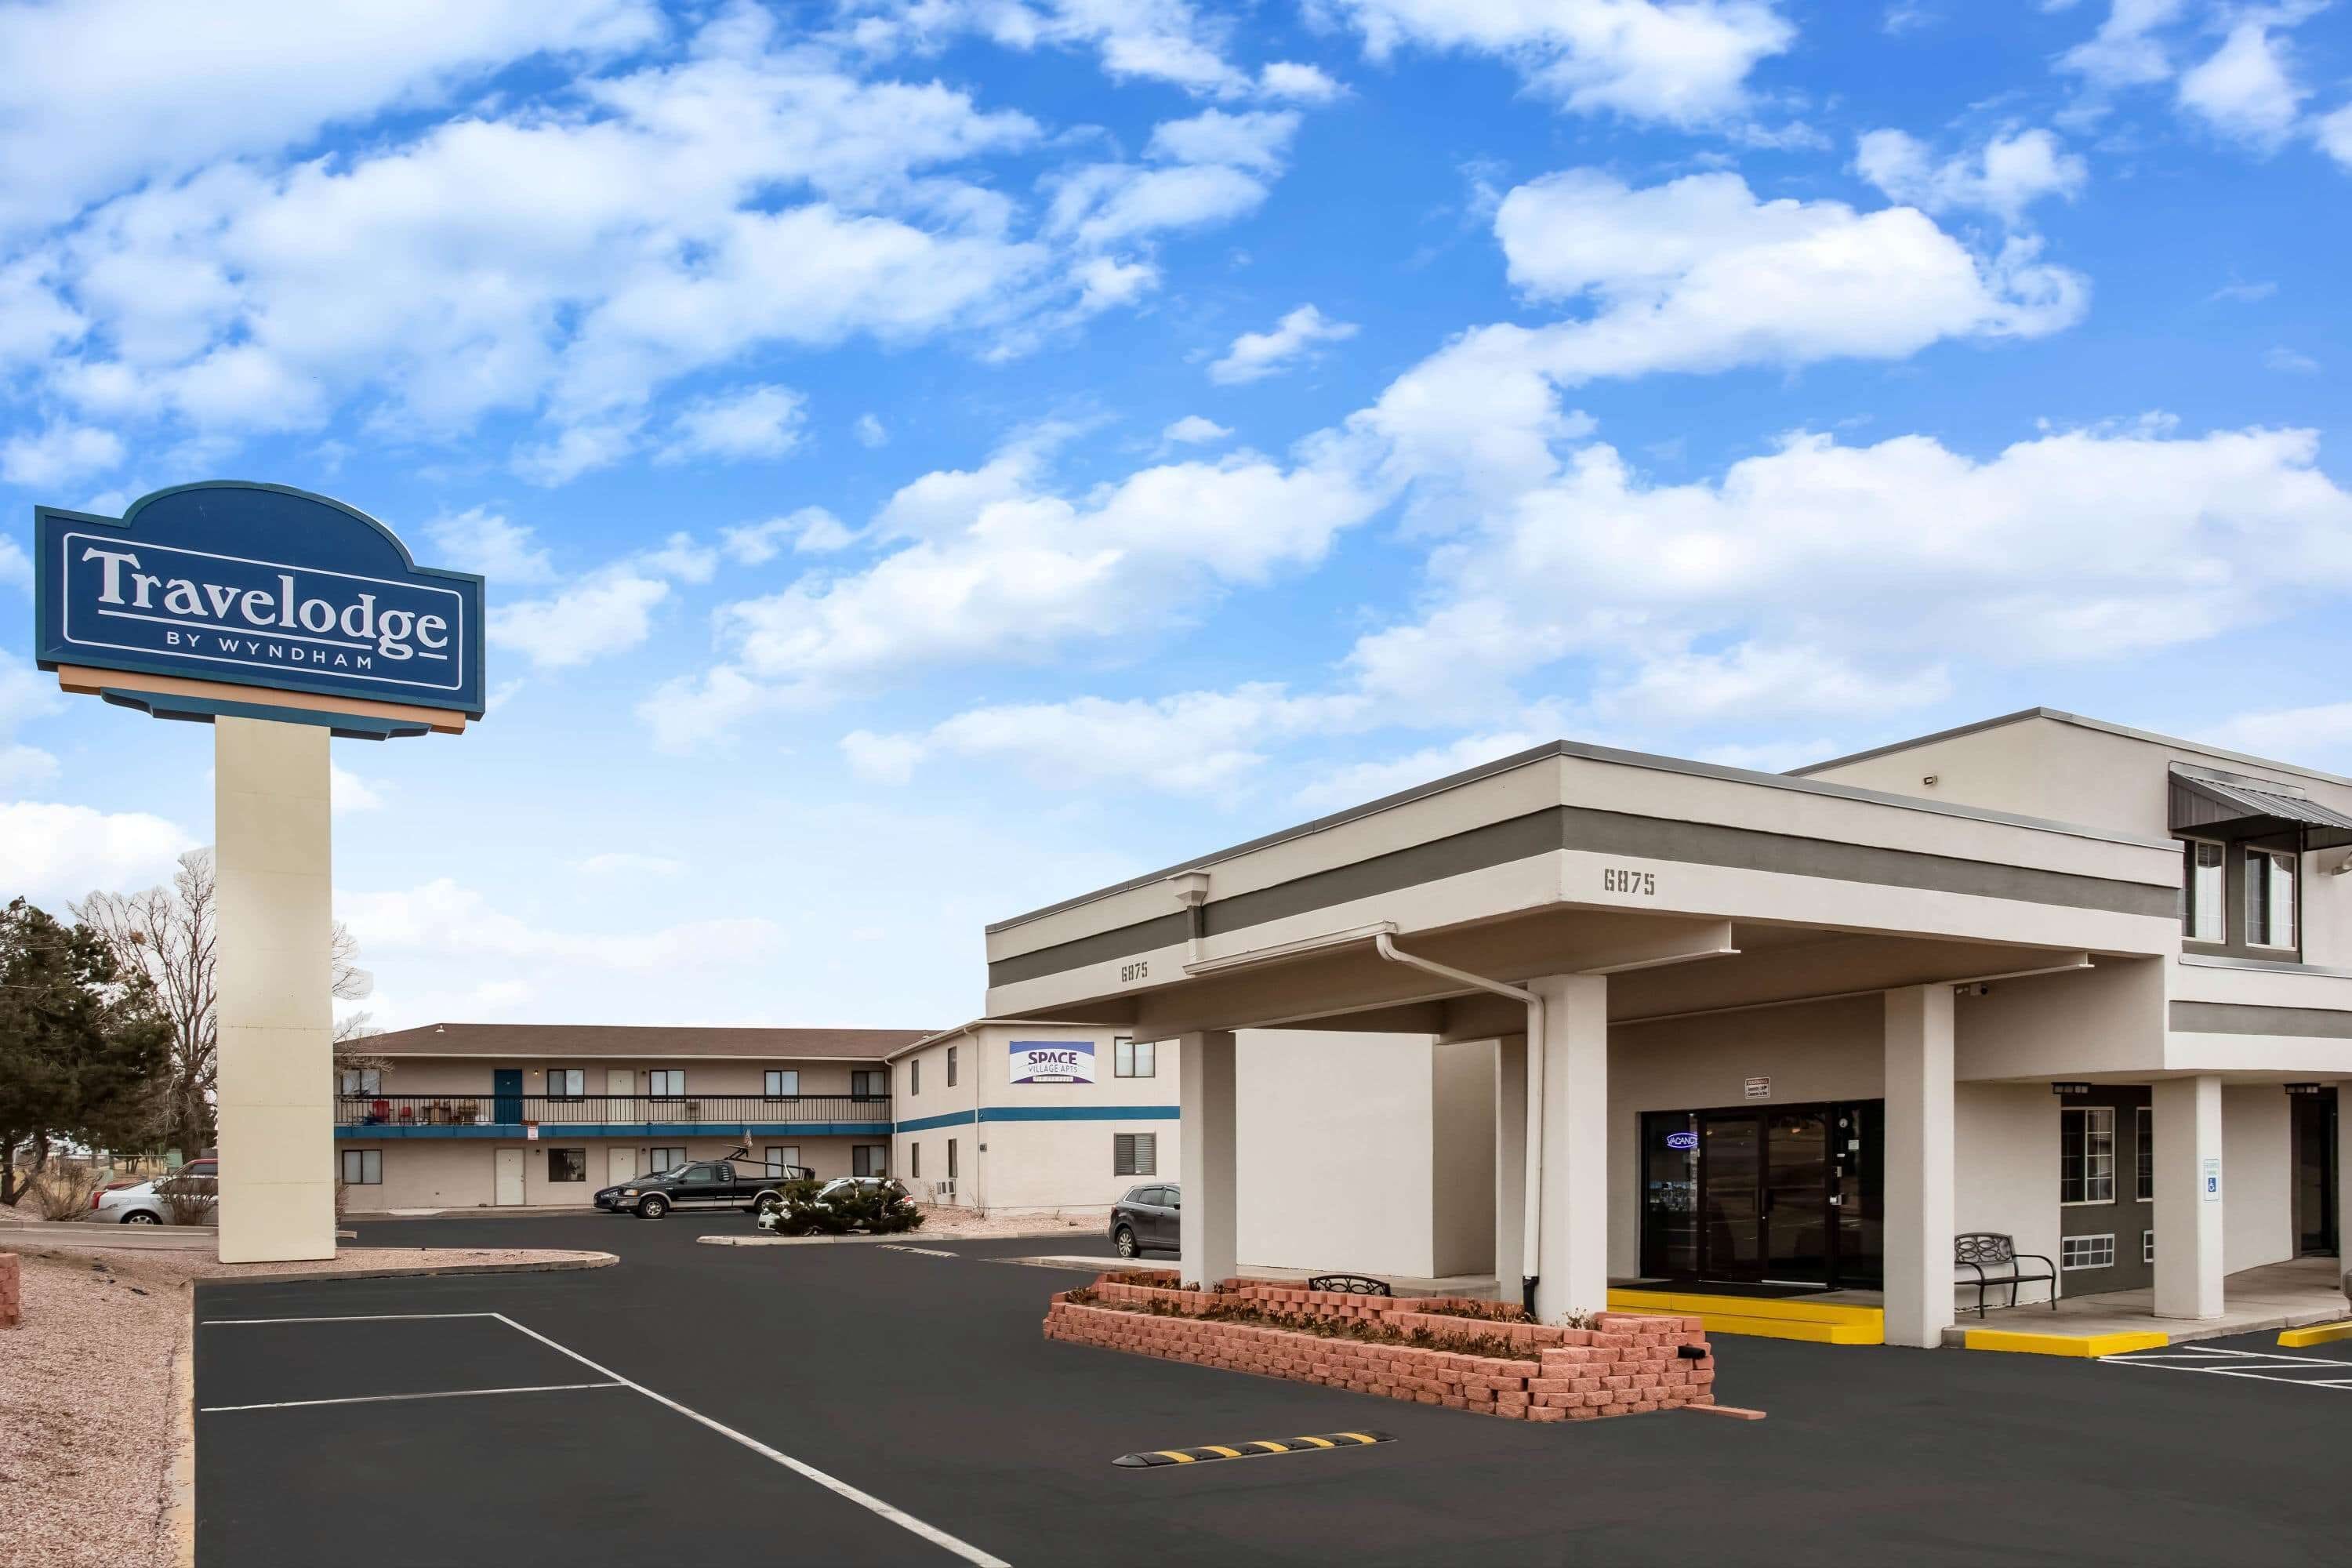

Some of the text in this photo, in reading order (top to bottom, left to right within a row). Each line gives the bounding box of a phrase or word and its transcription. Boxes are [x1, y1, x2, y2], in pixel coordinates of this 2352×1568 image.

[82, 547, 448, 660] Travelodge
[166, 631, 372, 670] BY WYNDHAM
[1604, 869, 1655, 895] 6875
[1121, 961, 1148, 982] 6875
[1028, 1051, 1078, 1065] SPACE
[1028, 1064, 1078, 1073] VILLAGE APTS
